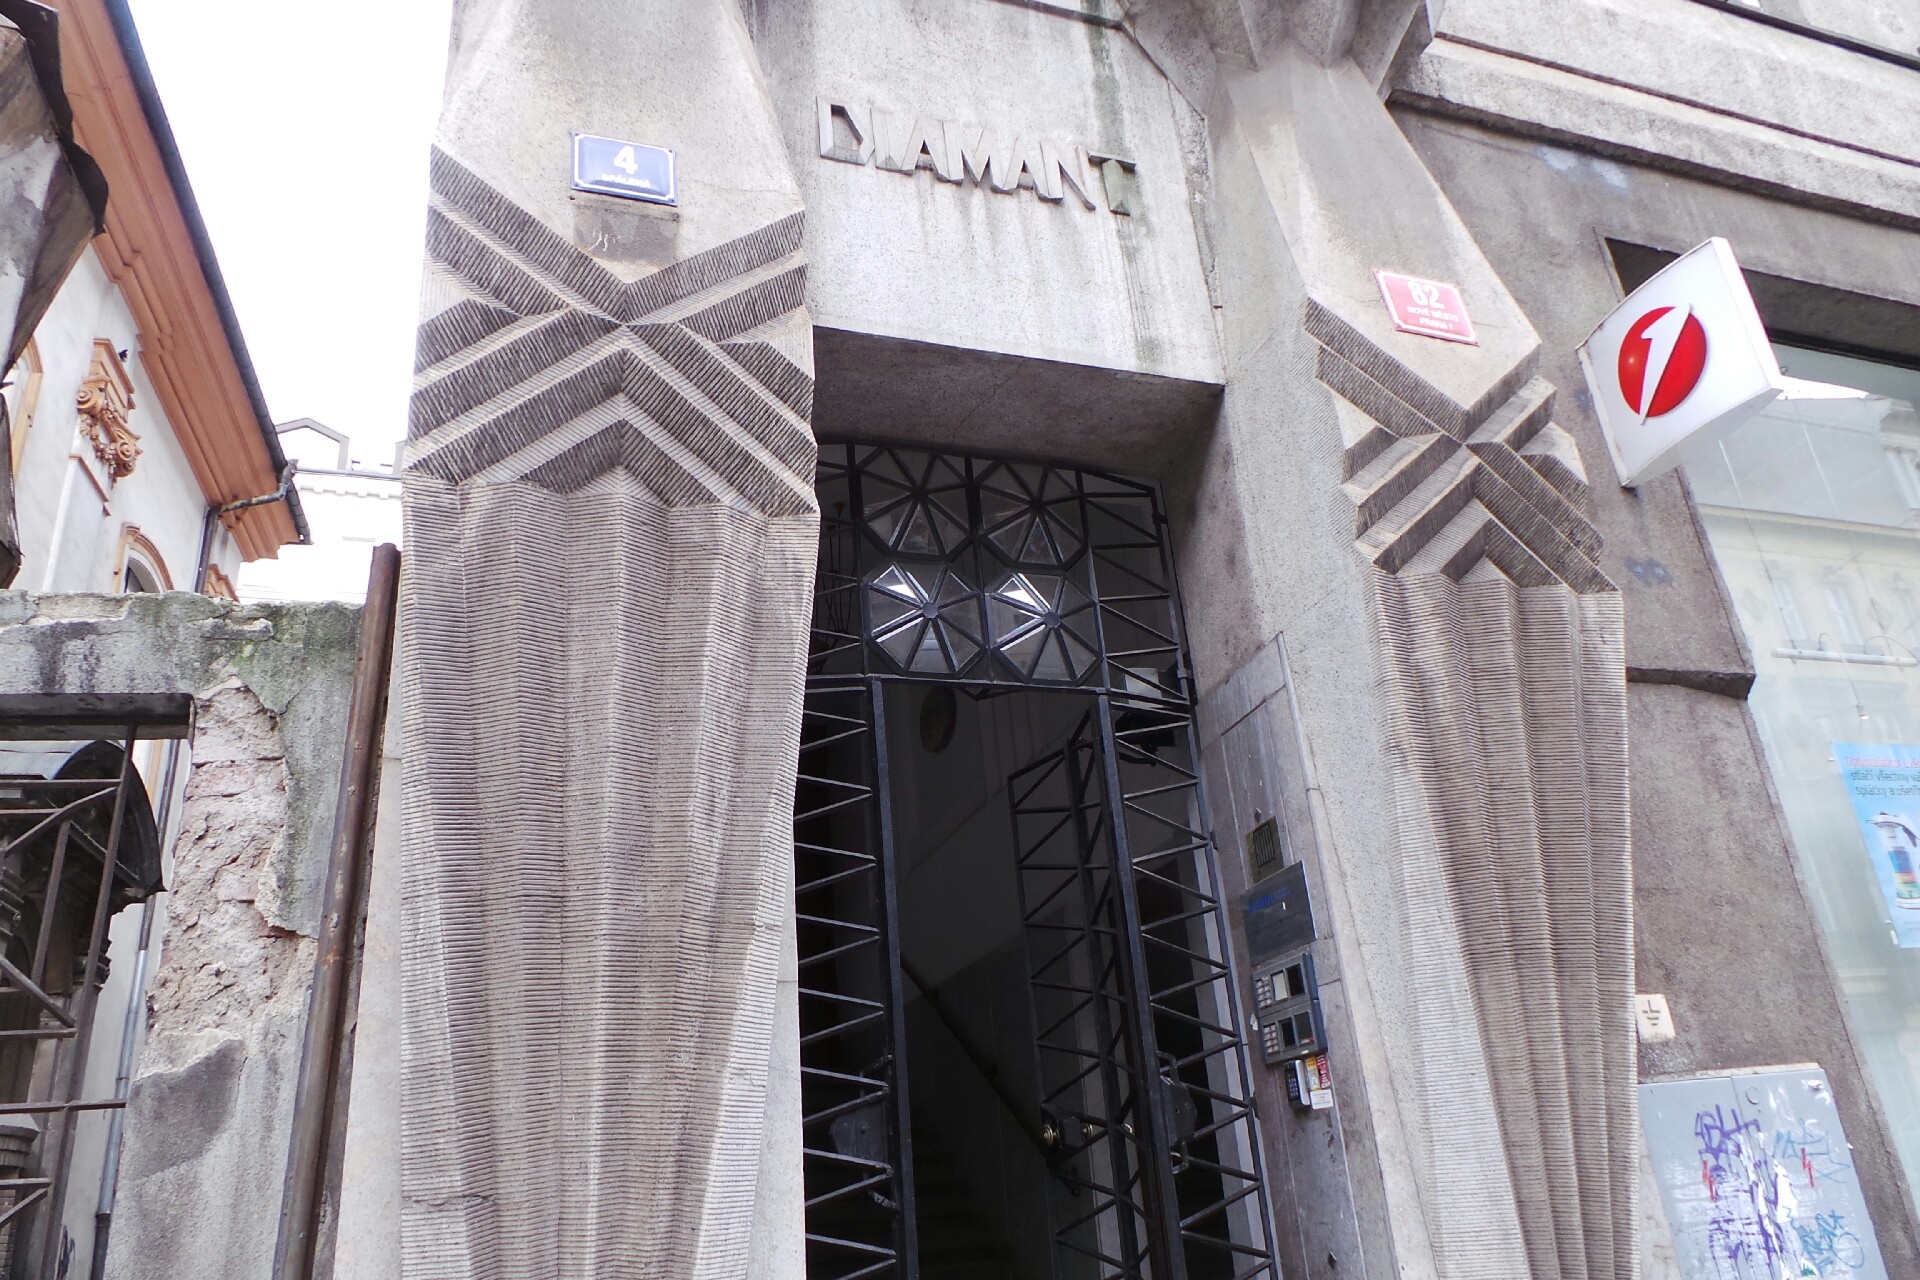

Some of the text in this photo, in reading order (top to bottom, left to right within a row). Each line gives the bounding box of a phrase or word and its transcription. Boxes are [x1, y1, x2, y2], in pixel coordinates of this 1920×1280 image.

[613, 145, 639, 175] 4
[816, 96, 1137, 217] DIAMANT
[1407, 281, 1445, 309] 82
[1407, 306, 1459, 322] NOVÉ MĚSTO
[1419, 317, 1448, 330] PRAHA
